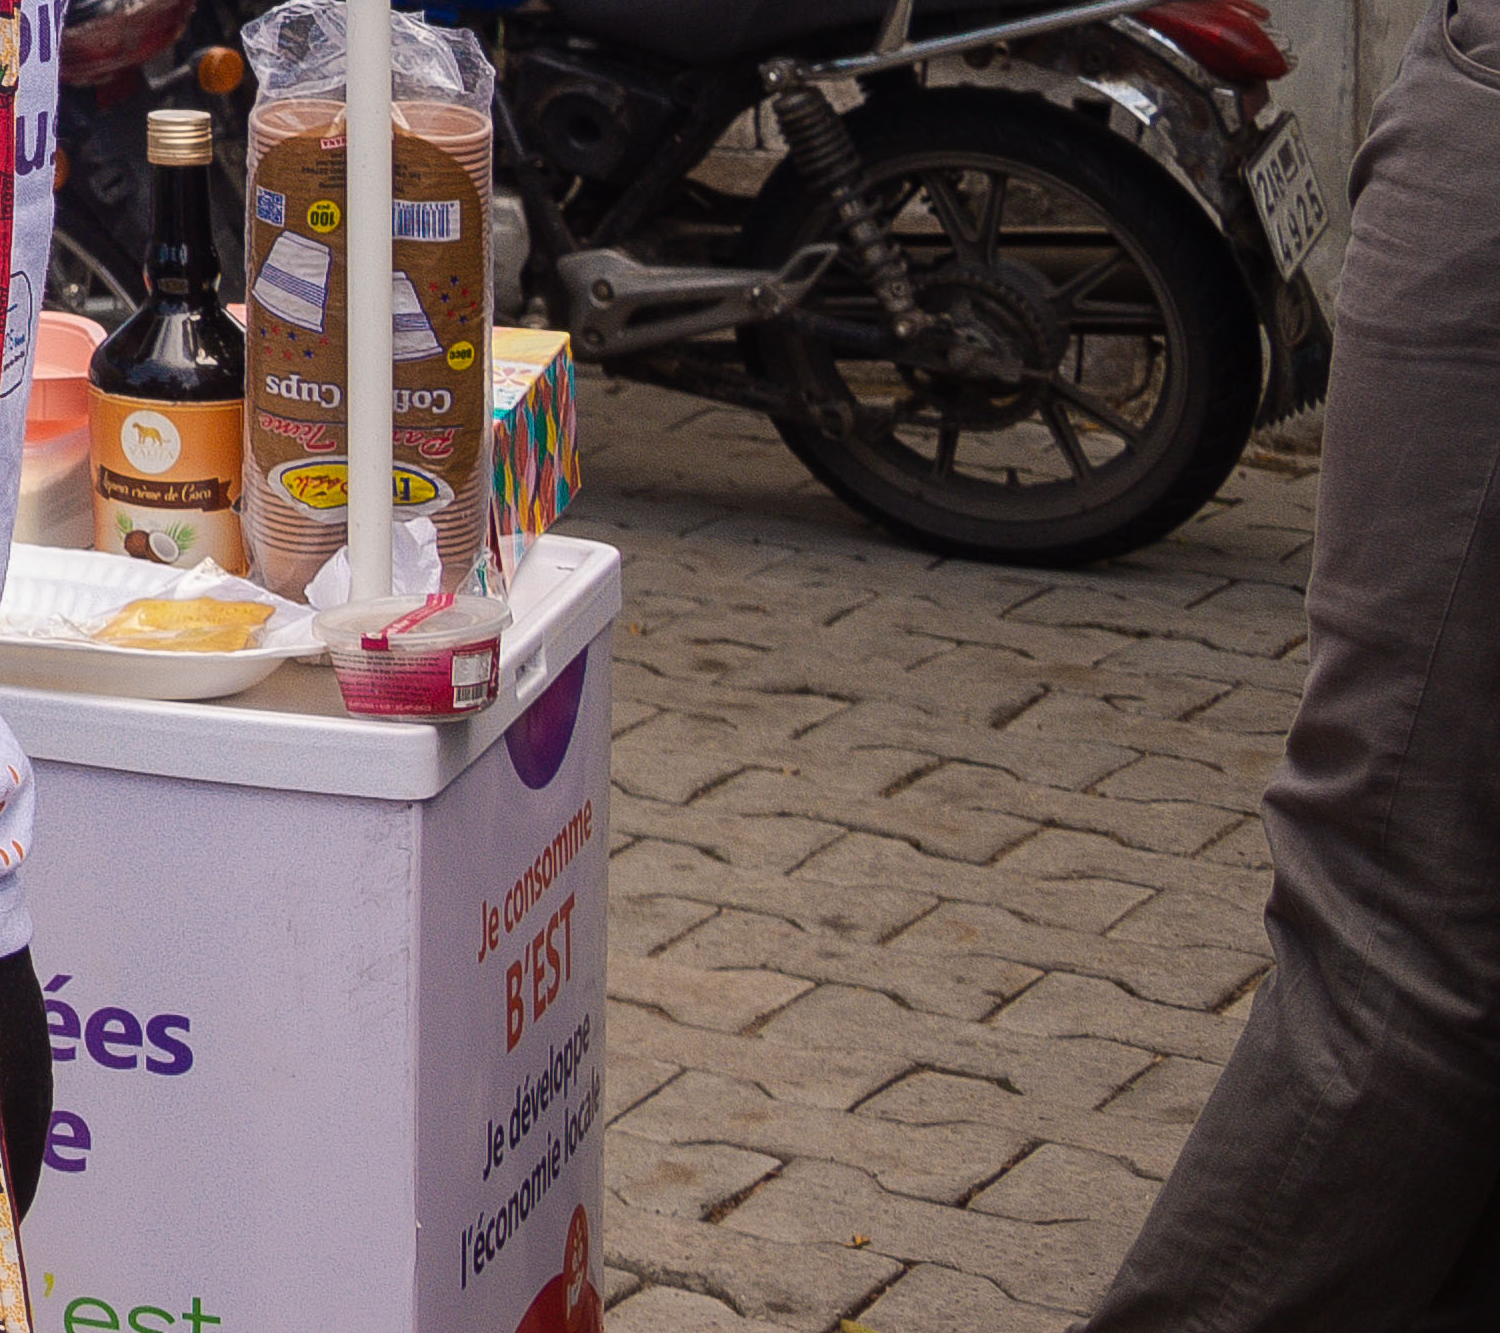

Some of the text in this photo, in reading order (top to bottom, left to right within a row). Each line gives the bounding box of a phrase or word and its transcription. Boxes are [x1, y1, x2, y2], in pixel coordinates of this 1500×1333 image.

[310, 211, 335, 227] 100
[260, 412, 337, 452] Time
[265, 373, 342, 409] Cups
[478, 798, 594, 964] Je consomme
[506, 892, 576, 1056] B'EST
[461, 1064, 601, 1291] l'économie locale
[482, 1012, 591, 1182] Je développe
